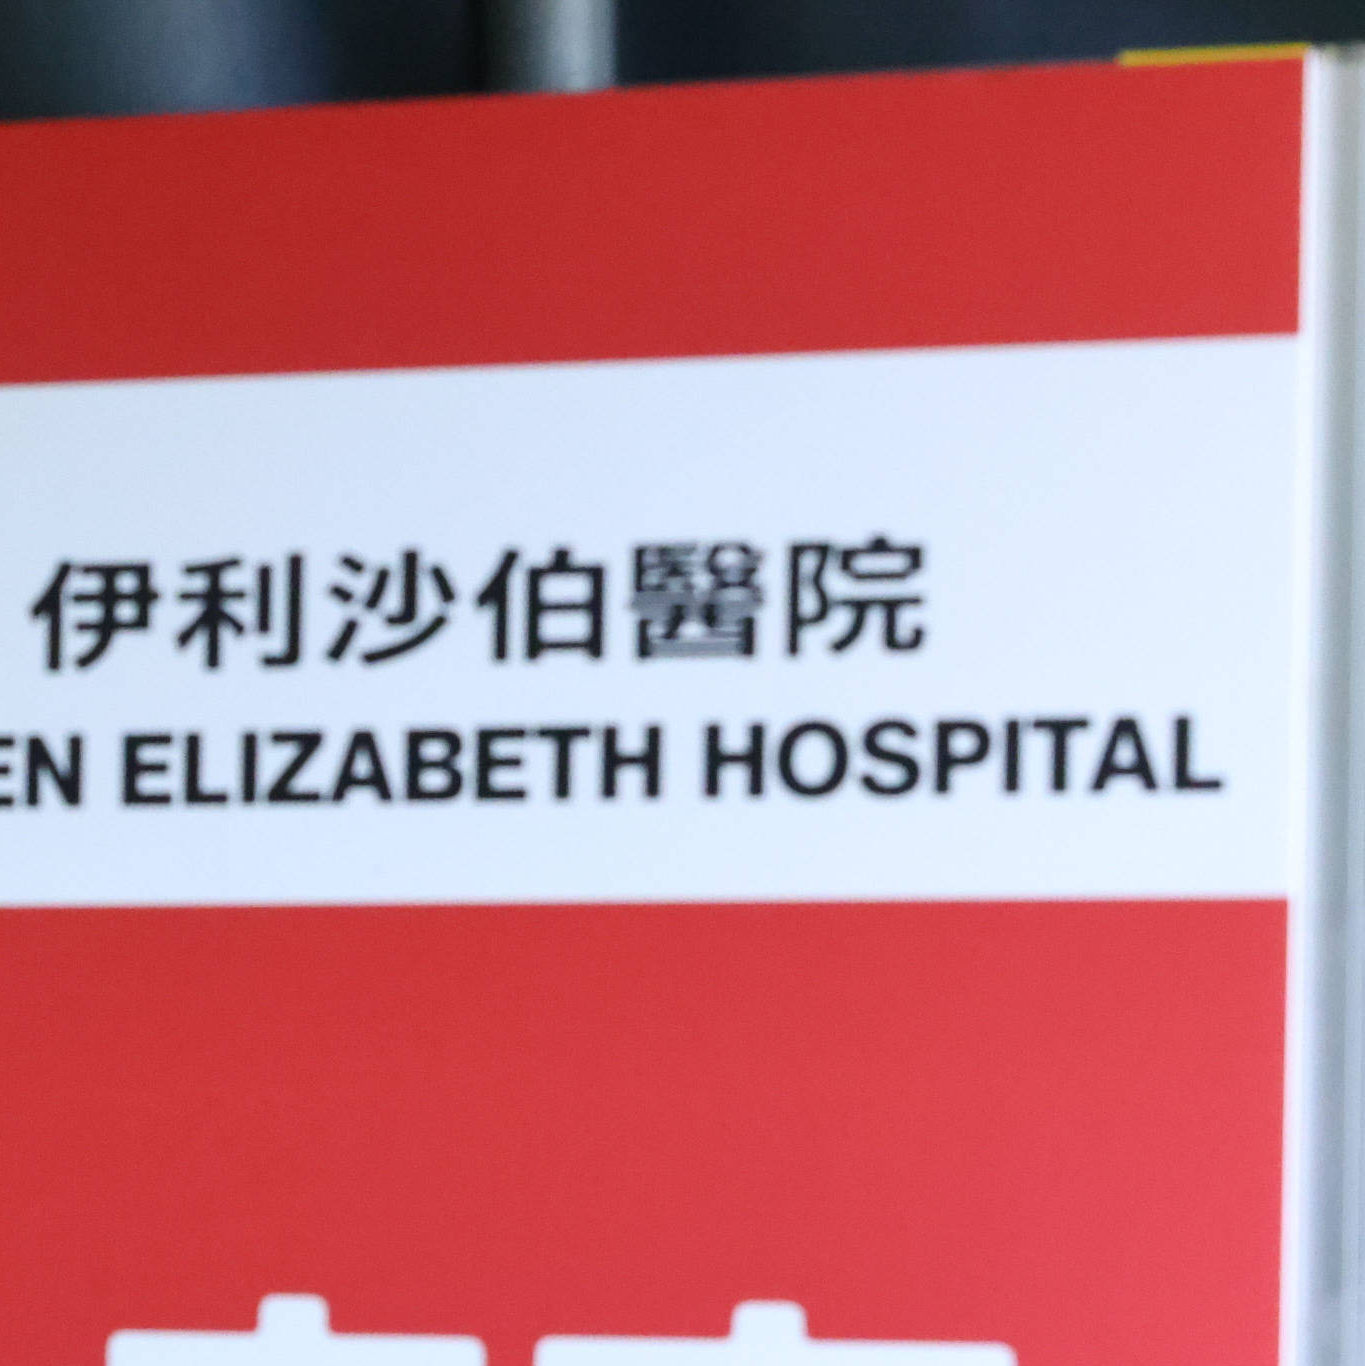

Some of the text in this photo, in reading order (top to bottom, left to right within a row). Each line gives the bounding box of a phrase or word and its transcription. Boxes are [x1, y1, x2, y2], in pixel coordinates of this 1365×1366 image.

[27, 535, 929, 672] 伊利沙伯醫院
[121, 726, 662, 807] ELIZABETH
[704, 717, 1222, 798] HOSPITAL
